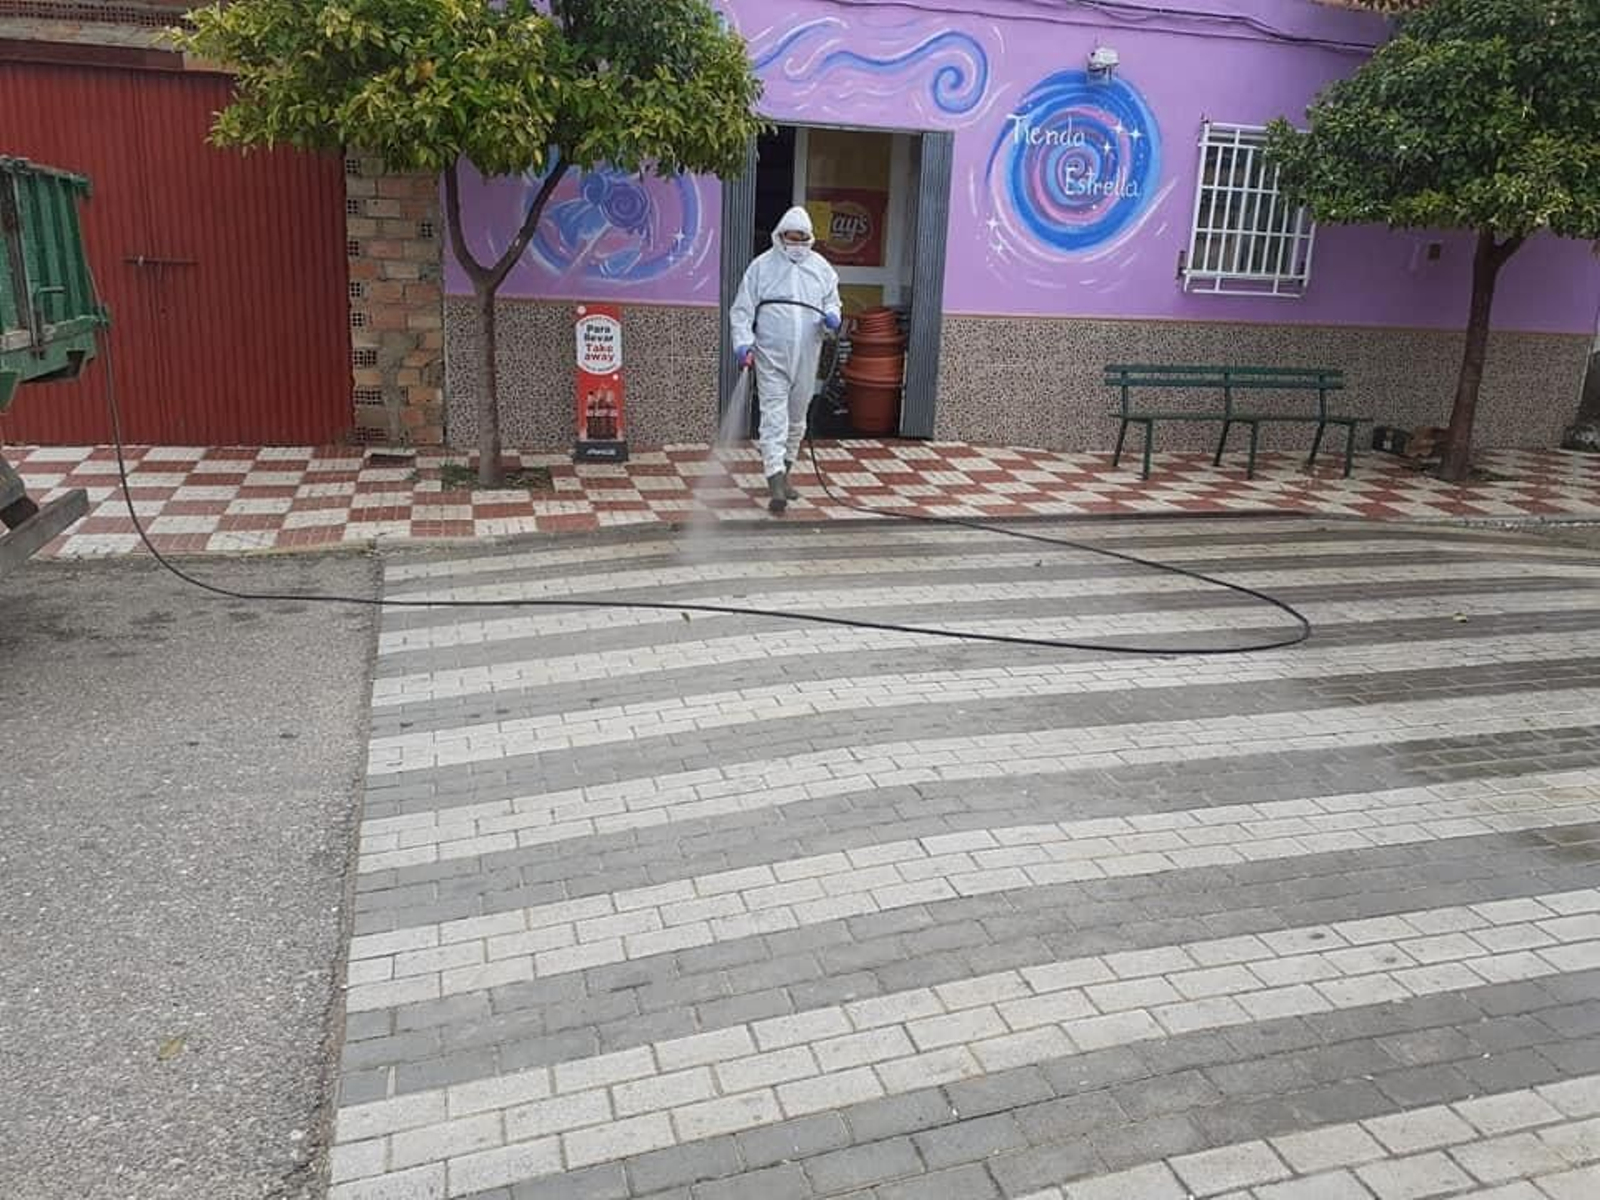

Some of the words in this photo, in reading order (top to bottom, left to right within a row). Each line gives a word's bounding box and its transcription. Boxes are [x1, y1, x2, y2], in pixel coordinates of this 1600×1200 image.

[1006, 113, 1085, 147] Tienda
[1064, 166, 1140, 199] Estrella
[831, 212, 868, 243] ay's
[586, 323, 611, 333] Para
[586, 343, 613, 352] Take
[584, 353, 614, 363] away
